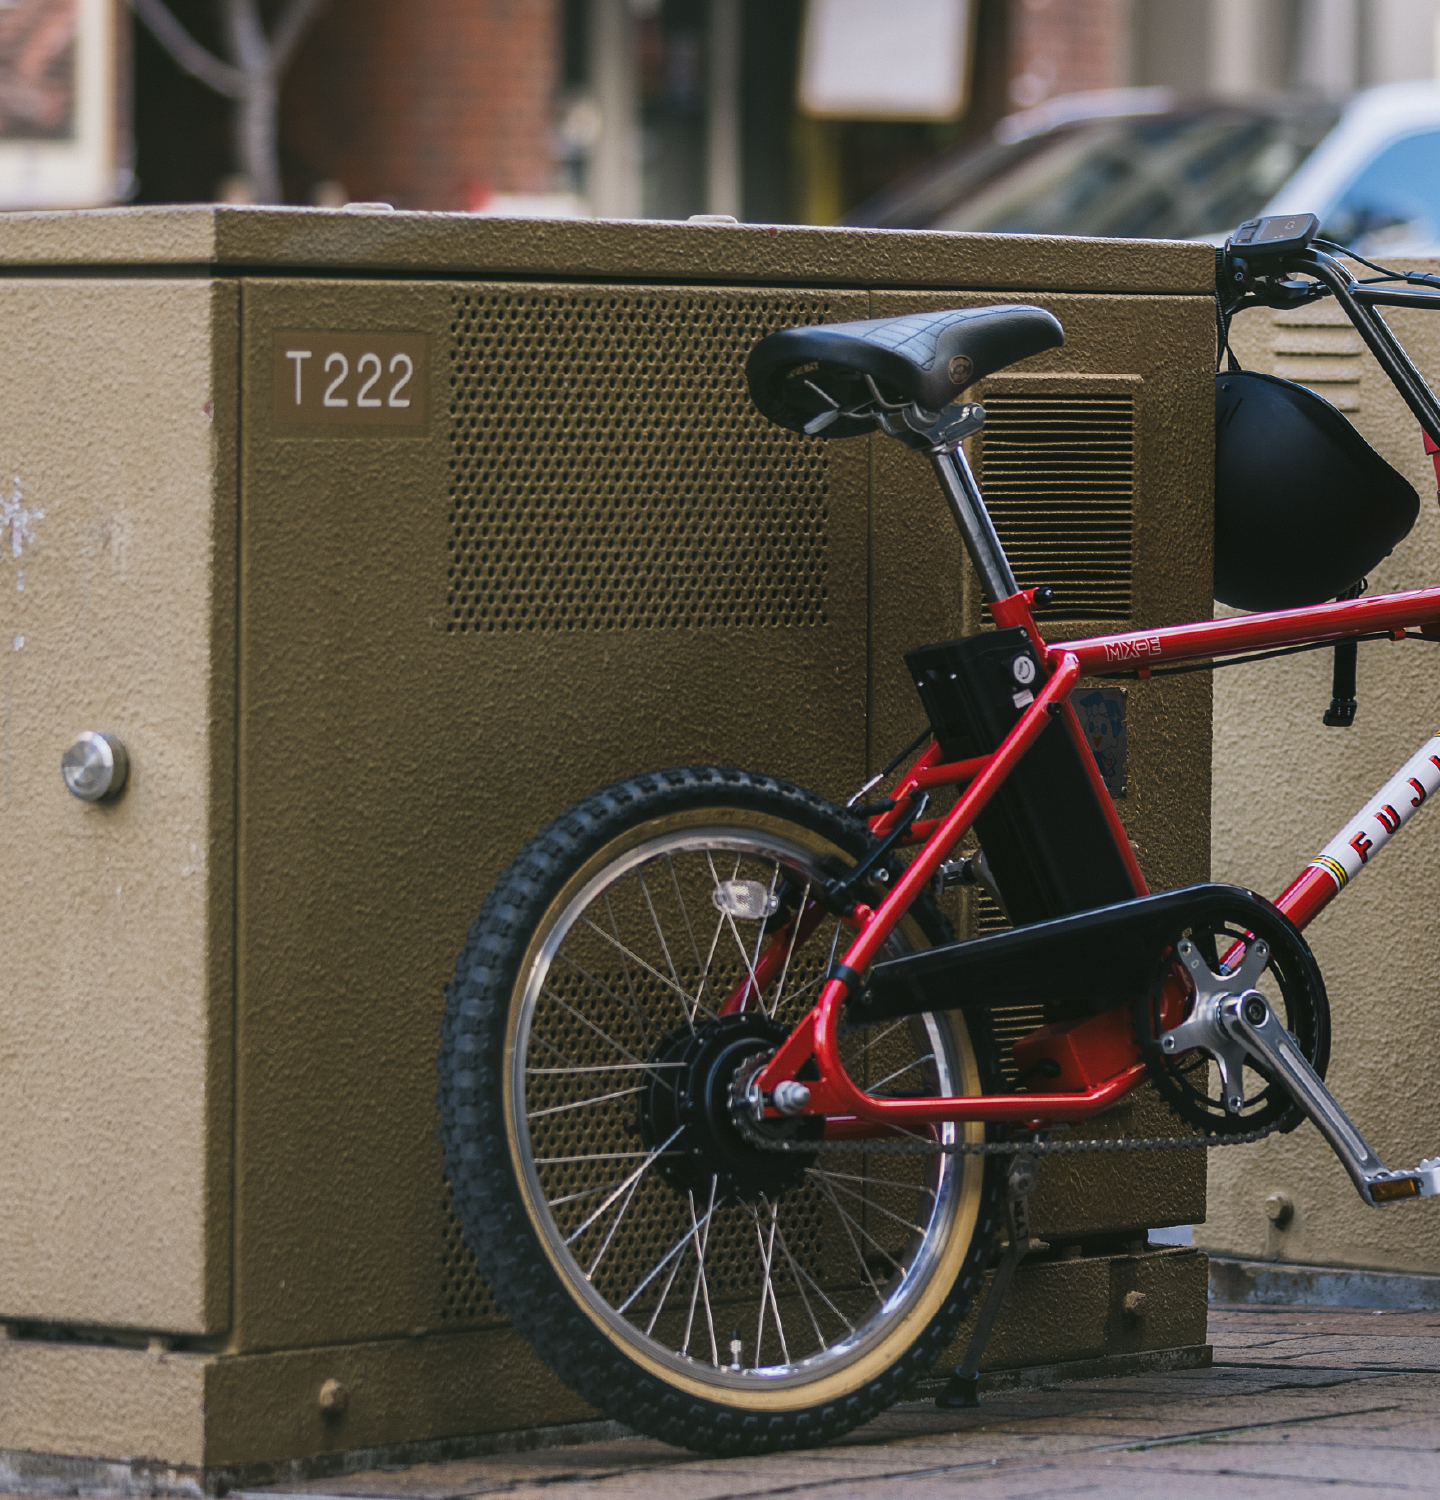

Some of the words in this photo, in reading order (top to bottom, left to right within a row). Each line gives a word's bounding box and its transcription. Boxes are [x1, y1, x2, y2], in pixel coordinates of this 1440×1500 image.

[286, 350, 312, 405] T
[323, 352, 413, 407] 222
[1103, 636, 1162, 662] MX-E
